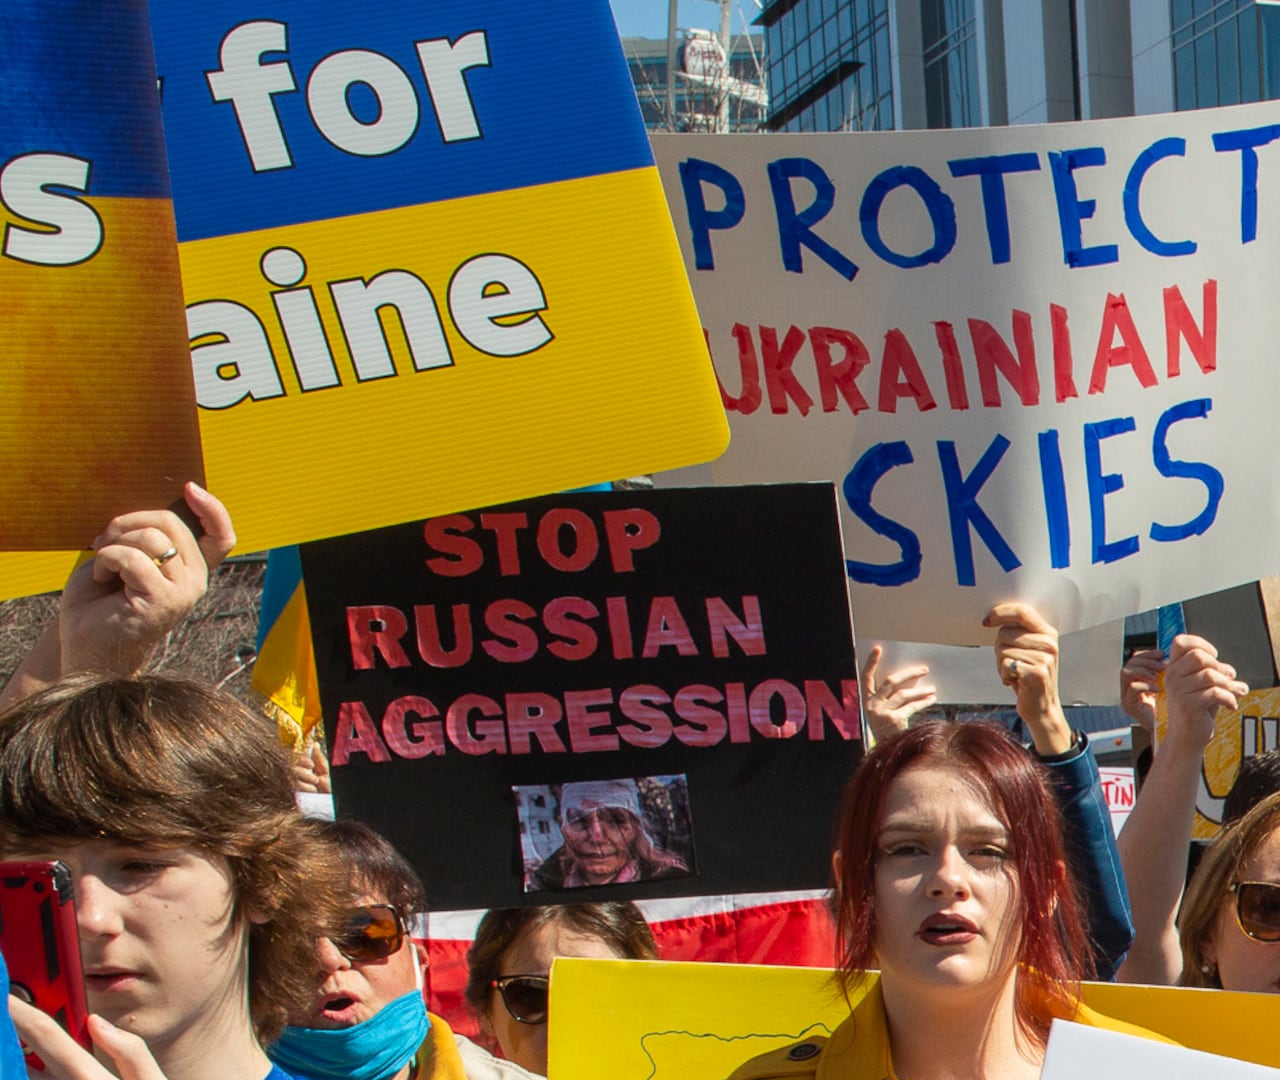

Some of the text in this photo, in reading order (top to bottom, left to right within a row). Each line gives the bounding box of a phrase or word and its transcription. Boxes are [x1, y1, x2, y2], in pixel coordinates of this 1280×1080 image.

[206, 19, 492, 172] for
[702, 279, 1218, 416] UKRAINIAN
[423, 508, 661, 577] STOP
[838, 397, 1225, 588] SKIES
[345, 595, 767, 670] RUSSIAN
[331, 679, 862, 767] AGGRESSION
